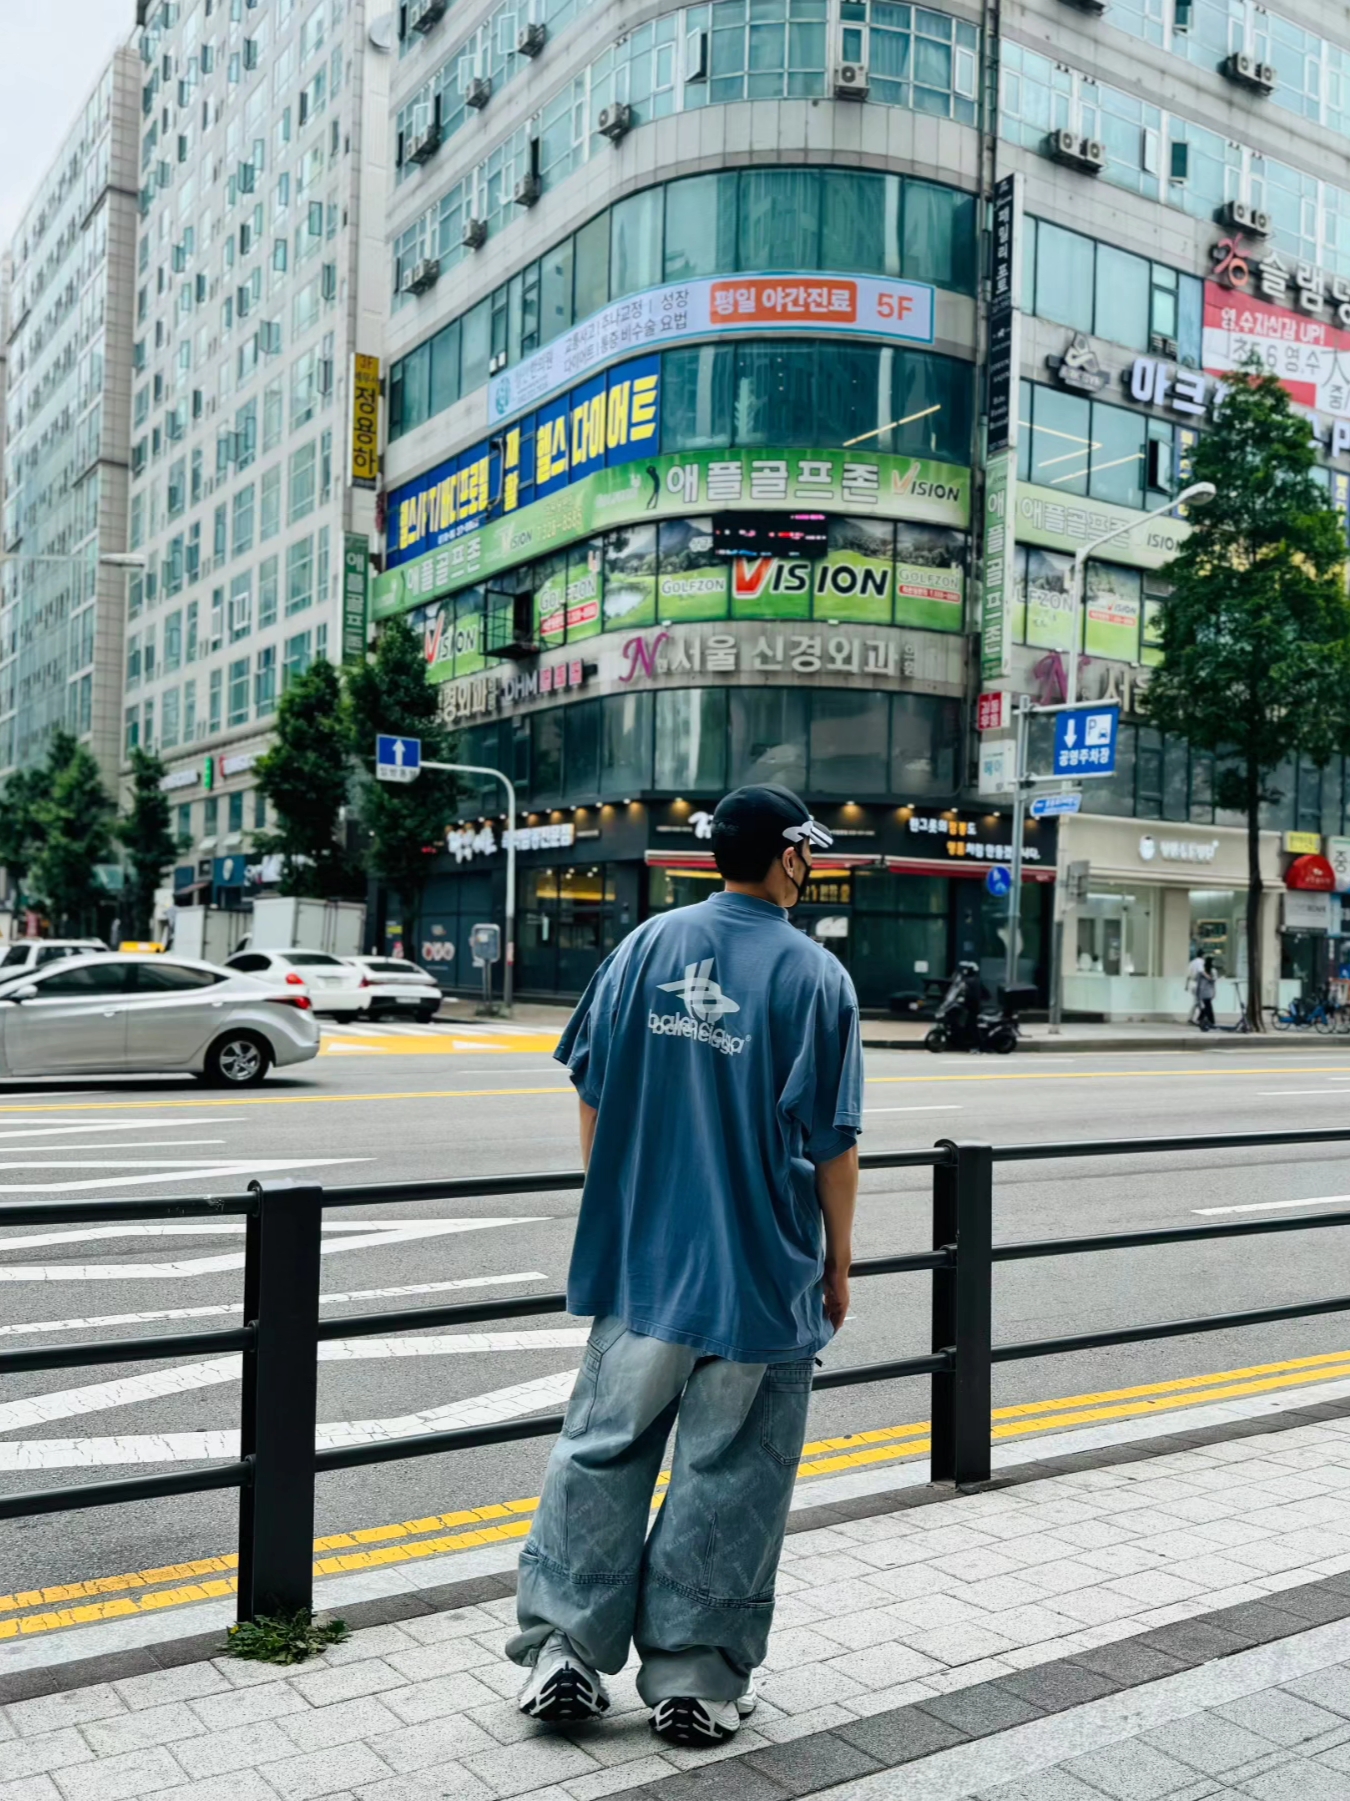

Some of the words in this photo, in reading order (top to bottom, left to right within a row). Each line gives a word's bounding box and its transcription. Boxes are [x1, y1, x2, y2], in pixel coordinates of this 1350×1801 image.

[661, 289, 690, 311] 성장
[713, 288, 759, 315] 평일
[762, 285, 852, 313] 야간진료
[876, 293, 914, 321] 5F
[660, 310, 688, 333] 요법
[666, 459, 880, 505] 애플골프존
[892, 462, 961, 502] VISION
[661, 577, 726, 596] GOLFZON
[733, 556, 889, 599] VISION
[898, 567, 960, 590] GOLFZON
[672, 634, 737, 672] 서울
[750, 635, 899, 677] 신경외과
[1058, 748, 1111, 768] 공영주차장
